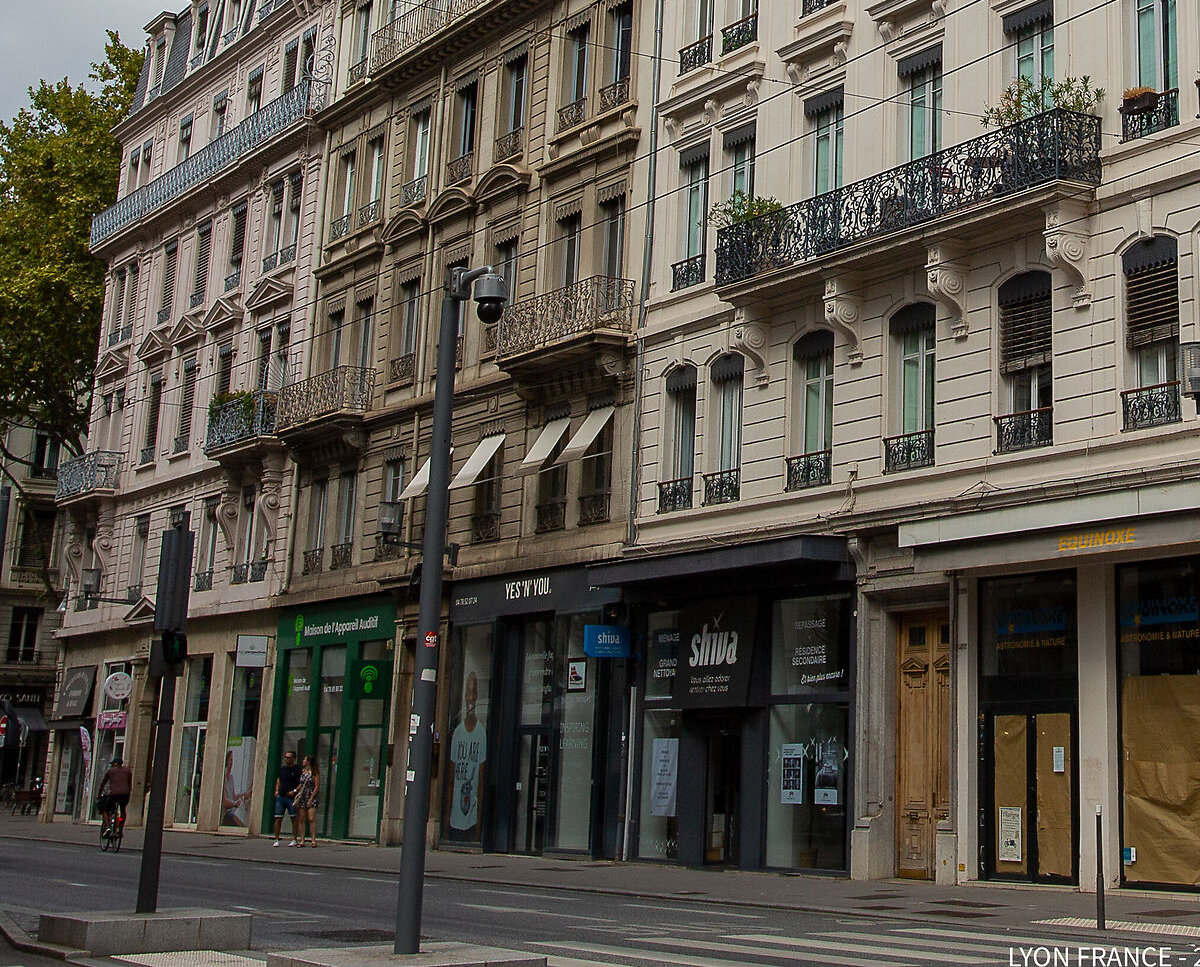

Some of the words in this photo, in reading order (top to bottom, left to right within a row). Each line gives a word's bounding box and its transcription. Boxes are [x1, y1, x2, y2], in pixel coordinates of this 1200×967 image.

[1058, 527, 1136, 551] EQUINOXE
[304, 624, 324, 636] Maison
[324, 622, 331, 634] de
[359, 615, 378, 630] Auditif
[795, 618, 826, 630] REPASSAGE
[598, 630, 620, 644] shiva
[1120, 630, 1164, 644] ASTRONOMIE
[1165, 630, 1170, 640] &
[1172, 628, 1200, 640] NATURE
[688, 623, 738, 668] shiva
[658, 658, 677, 668] GRAND
[458, 740, 468, 758] YOU
